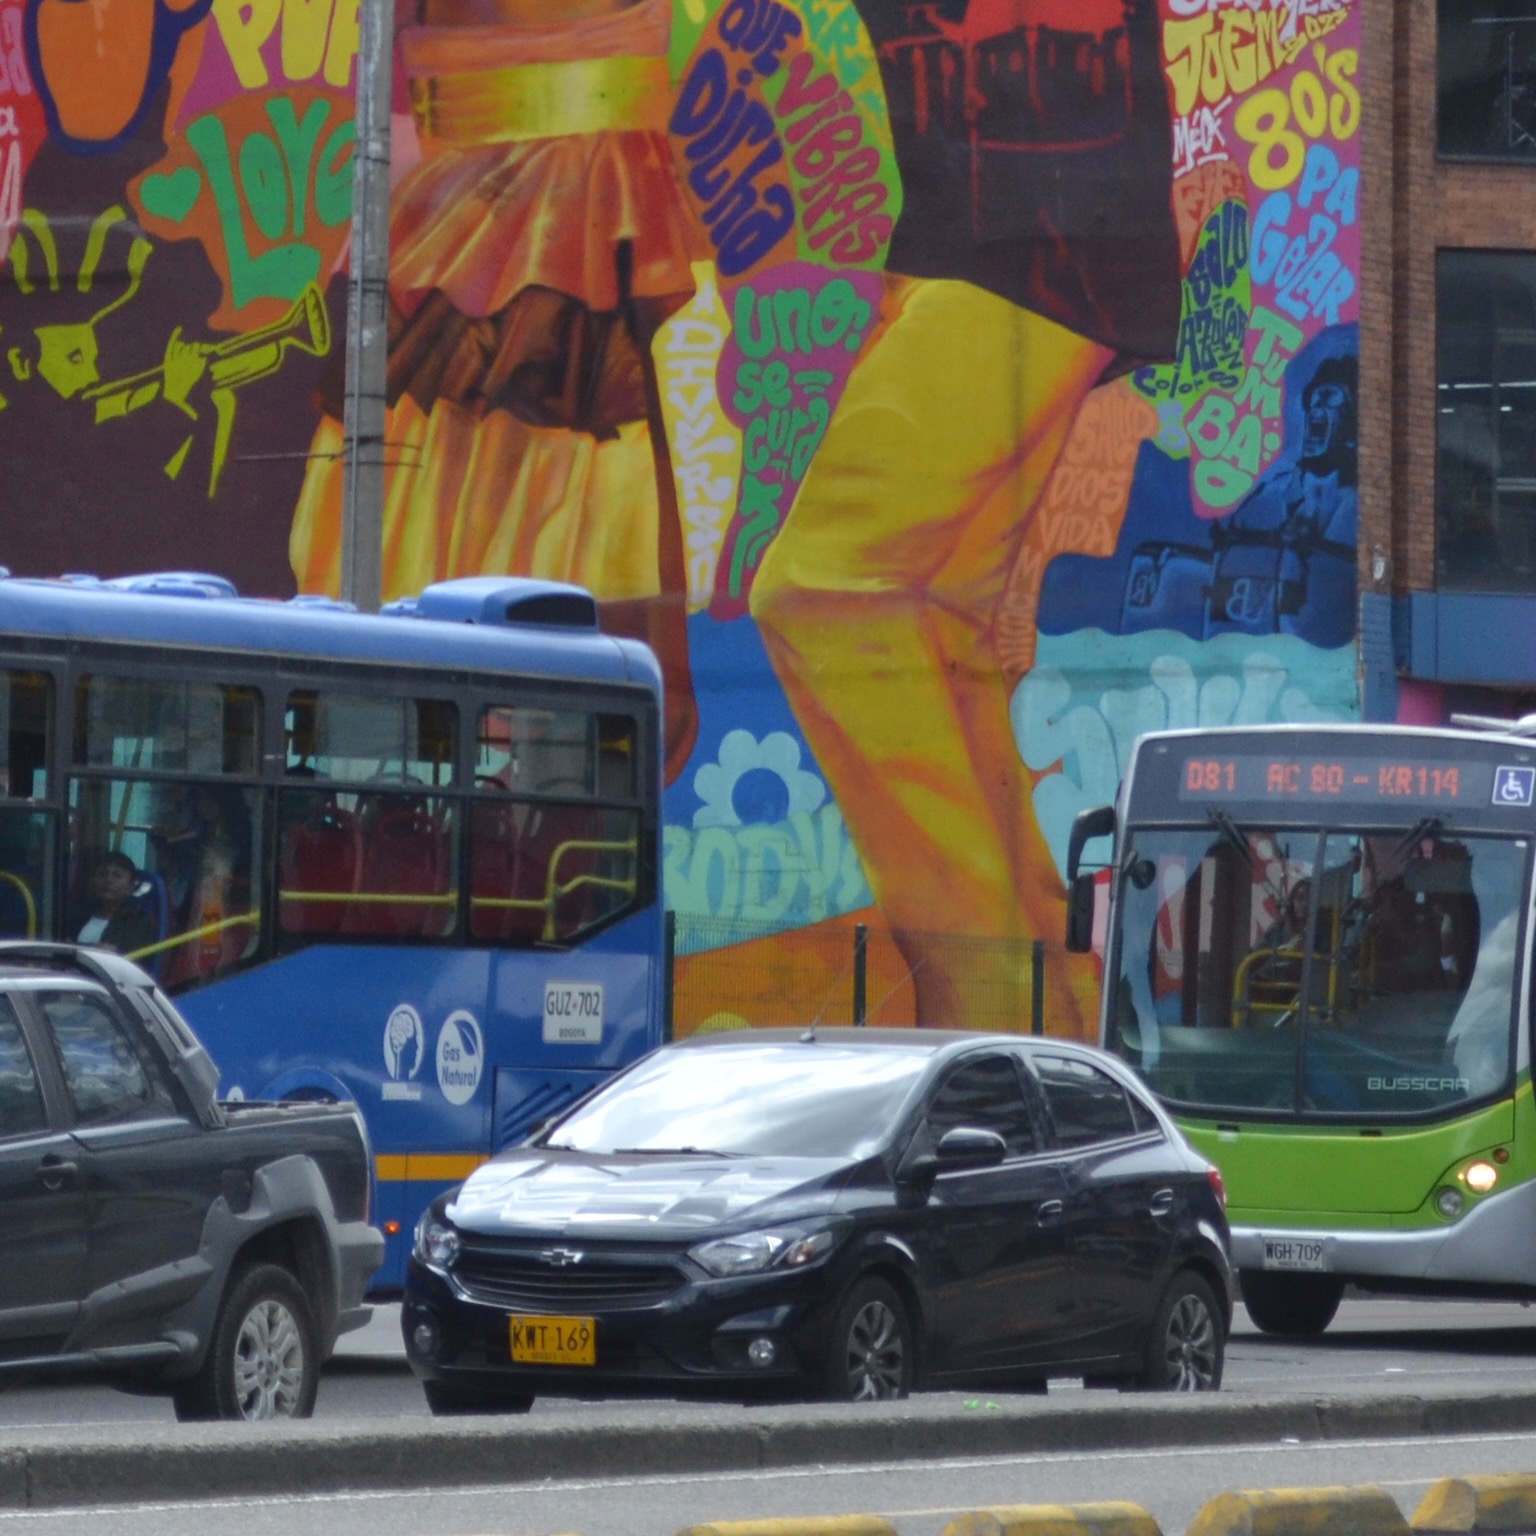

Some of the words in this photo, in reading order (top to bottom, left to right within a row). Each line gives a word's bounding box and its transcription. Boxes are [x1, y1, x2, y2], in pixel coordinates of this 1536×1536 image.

[1186, 761, 1237, 792] D81
[1267, 760, 1298, 792] AC
[1311, 762, 1344, 793] 80
[442, 1042, 461, 1062] Gas
[441, 1066, 477, 1088] Natural
[1367, 1076, 1470, 1092] BUSSCAR
